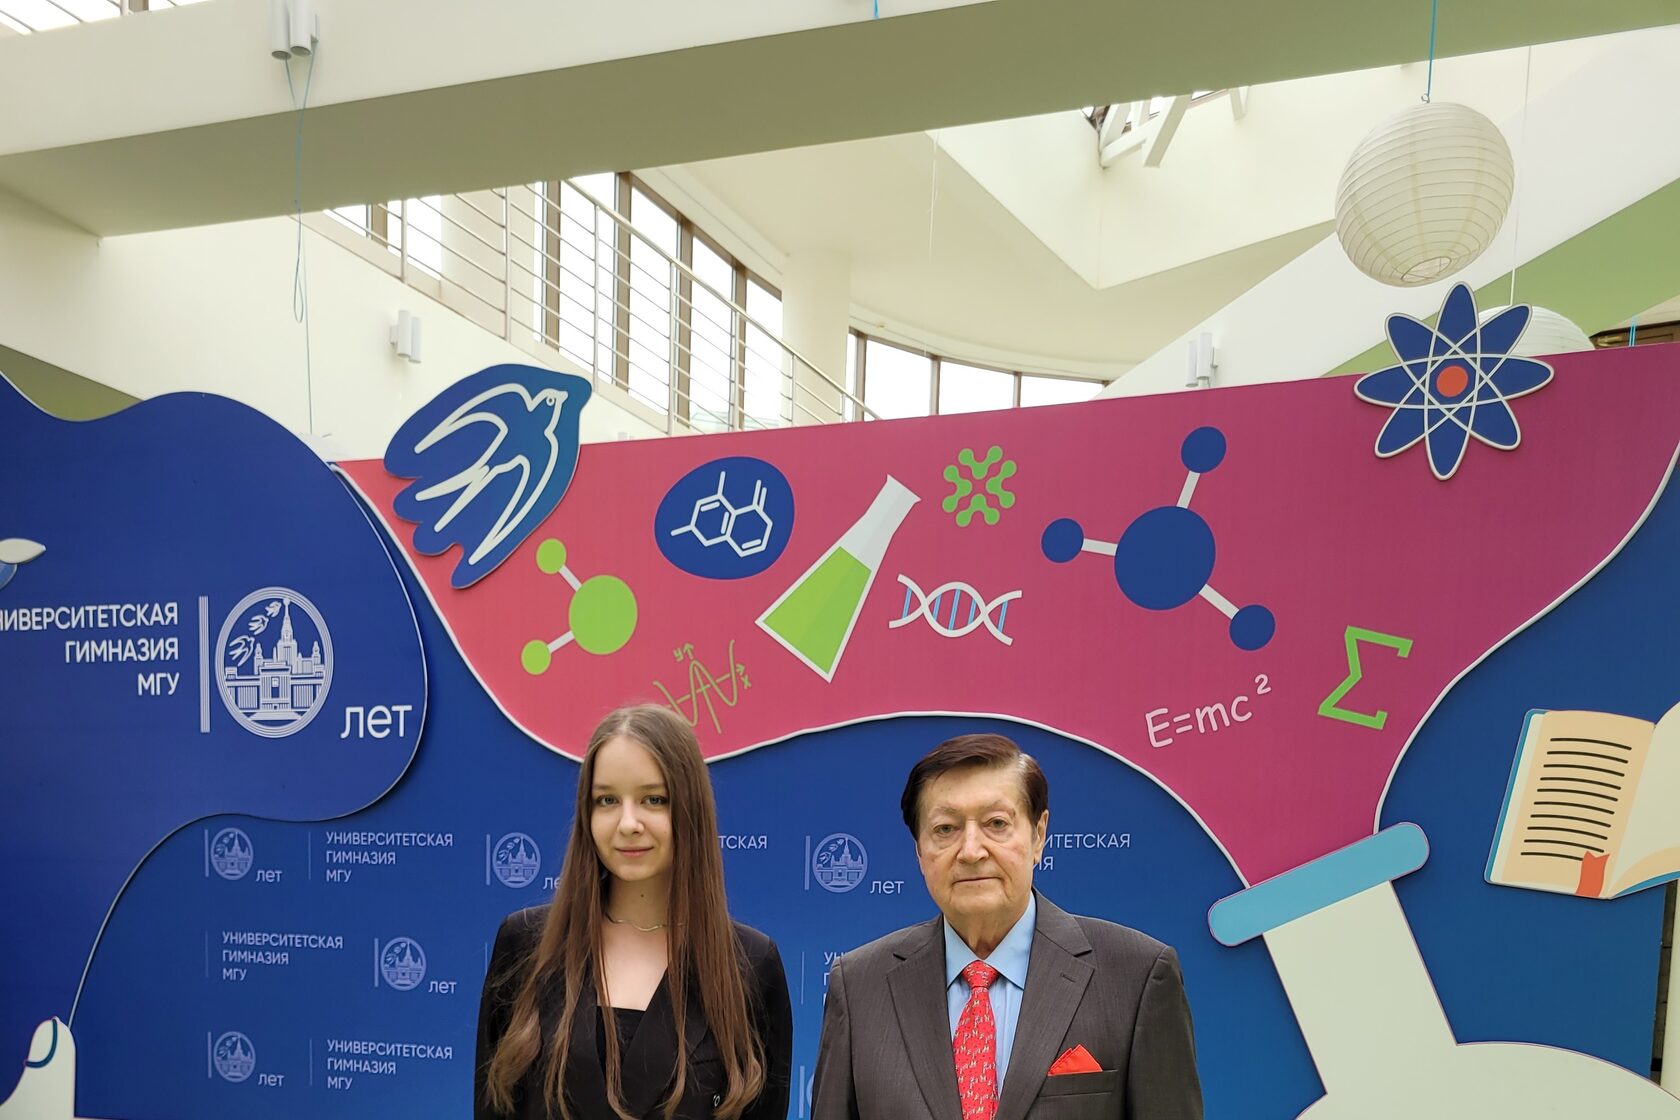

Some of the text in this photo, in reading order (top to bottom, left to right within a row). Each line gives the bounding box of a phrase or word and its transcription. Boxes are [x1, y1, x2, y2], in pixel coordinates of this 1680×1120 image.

[0, 602, 178, 631] ИВЕРСИТЕТСКАЯ
[65, 637, 179, 663] ГИМНАЗИЯ
[137, 672, 180, 696] МГУ
[340, 705, 412, 738] лет
[326, 831, 453, 847] УНИВЕРСИТЕТСКАЯ
[326, 851, 396, 865] ГИМНАЗИЯ
[256, 869, 283, 883] лет
[326, 869, 352, 883] МГУ
[870, 880, 905, 894] лет
[222, 931, 344, 949] УНИВЕРСИТЕТСКАЯ
[222, 950, 289, 965] ГИМНАЗИЯ
[222, 968, 247, 981] МГУ
[428, 980, 457, 994] лет
[327, 1039, 453, 1060] УНИВЕРСИТЕТСКАЯ
[327, 1058, 397, 1075] ГИМНАЗИЯ
[258, 1073, 284, 1087] лет
[327, 1076, 353, 1090] МГУ
